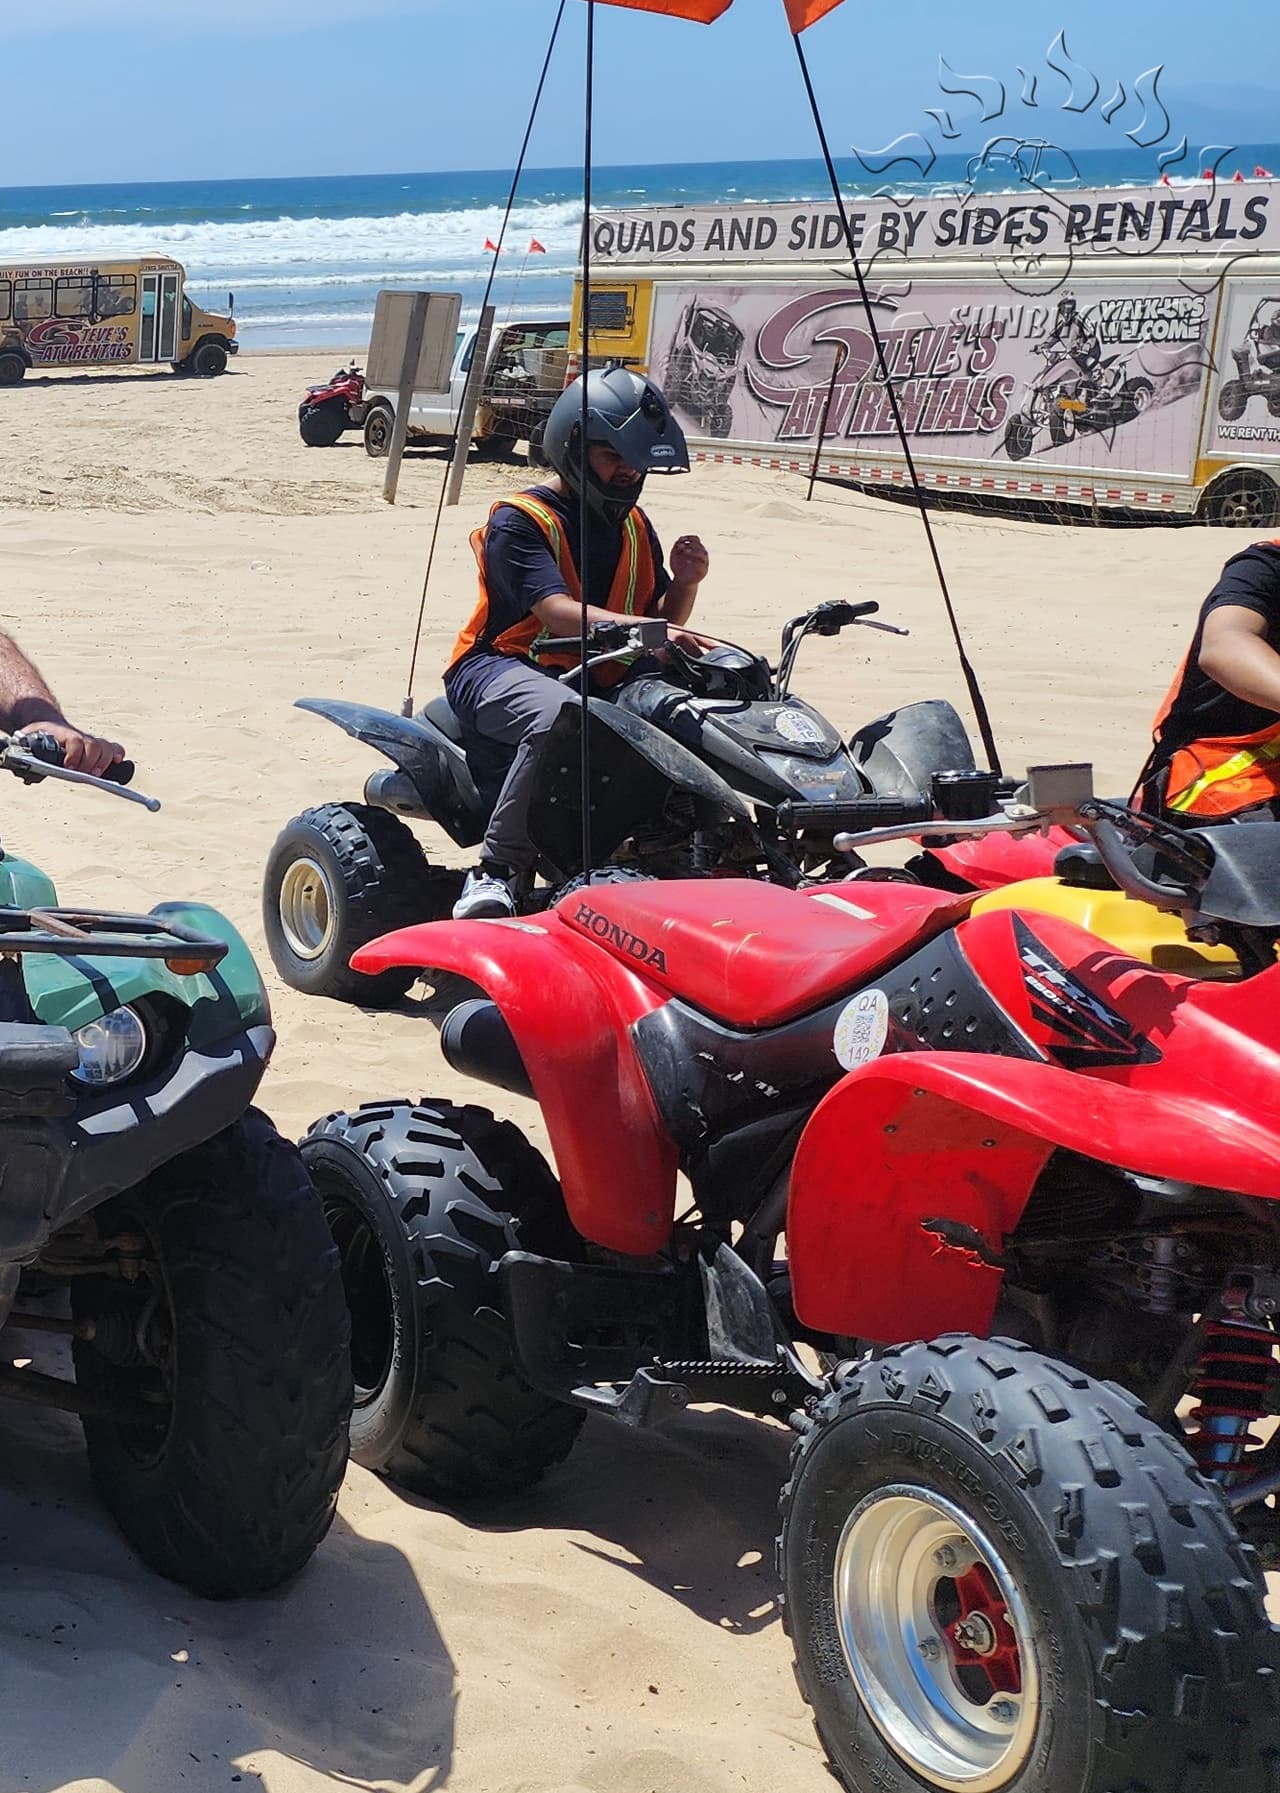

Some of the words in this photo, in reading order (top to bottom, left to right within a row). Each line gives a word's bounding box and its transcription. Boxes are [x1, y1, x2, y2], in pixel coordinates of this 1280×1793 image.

[593, 219, 696, 256] QUADS
[704, 216, 778, 250] AND
[787, 213, 867, 250] SIDE
[877, 210, 927, 248] BY
[937, 206, 1049, 246] SIDES
[1065, 196, 1270, 243] RENTALS
[15, 270, 29, 279] FUN
[31, 270, 42, 278] ON
[44, 269, 58, 277] THE
[1100, 296, 1205, 320] WALK-UPS
[24, 317, 129, 354] STEVE'S
[746, 288, 1006, 404] STEVE'S
[1100, 318, 1201, 343] WELCOME
[42, 345, 71, 361] ATV
[70, 342, 134, 361] RENTALS
[778, 385, 853, 438] ATV
[846, 374, 1016, 437] RENTALS
[1218, 425, 1237, 439] WE
[1237, 426, 1267, 440] RENT
[574, 903, 668, 975] HONDA
[1021, 947, 1128, 1028] TRX
[859, 995, 878, 1012] QA
[848, 1046, 870, 1063] 142
[890, 1428, 1027, 1551] DUNLOP
